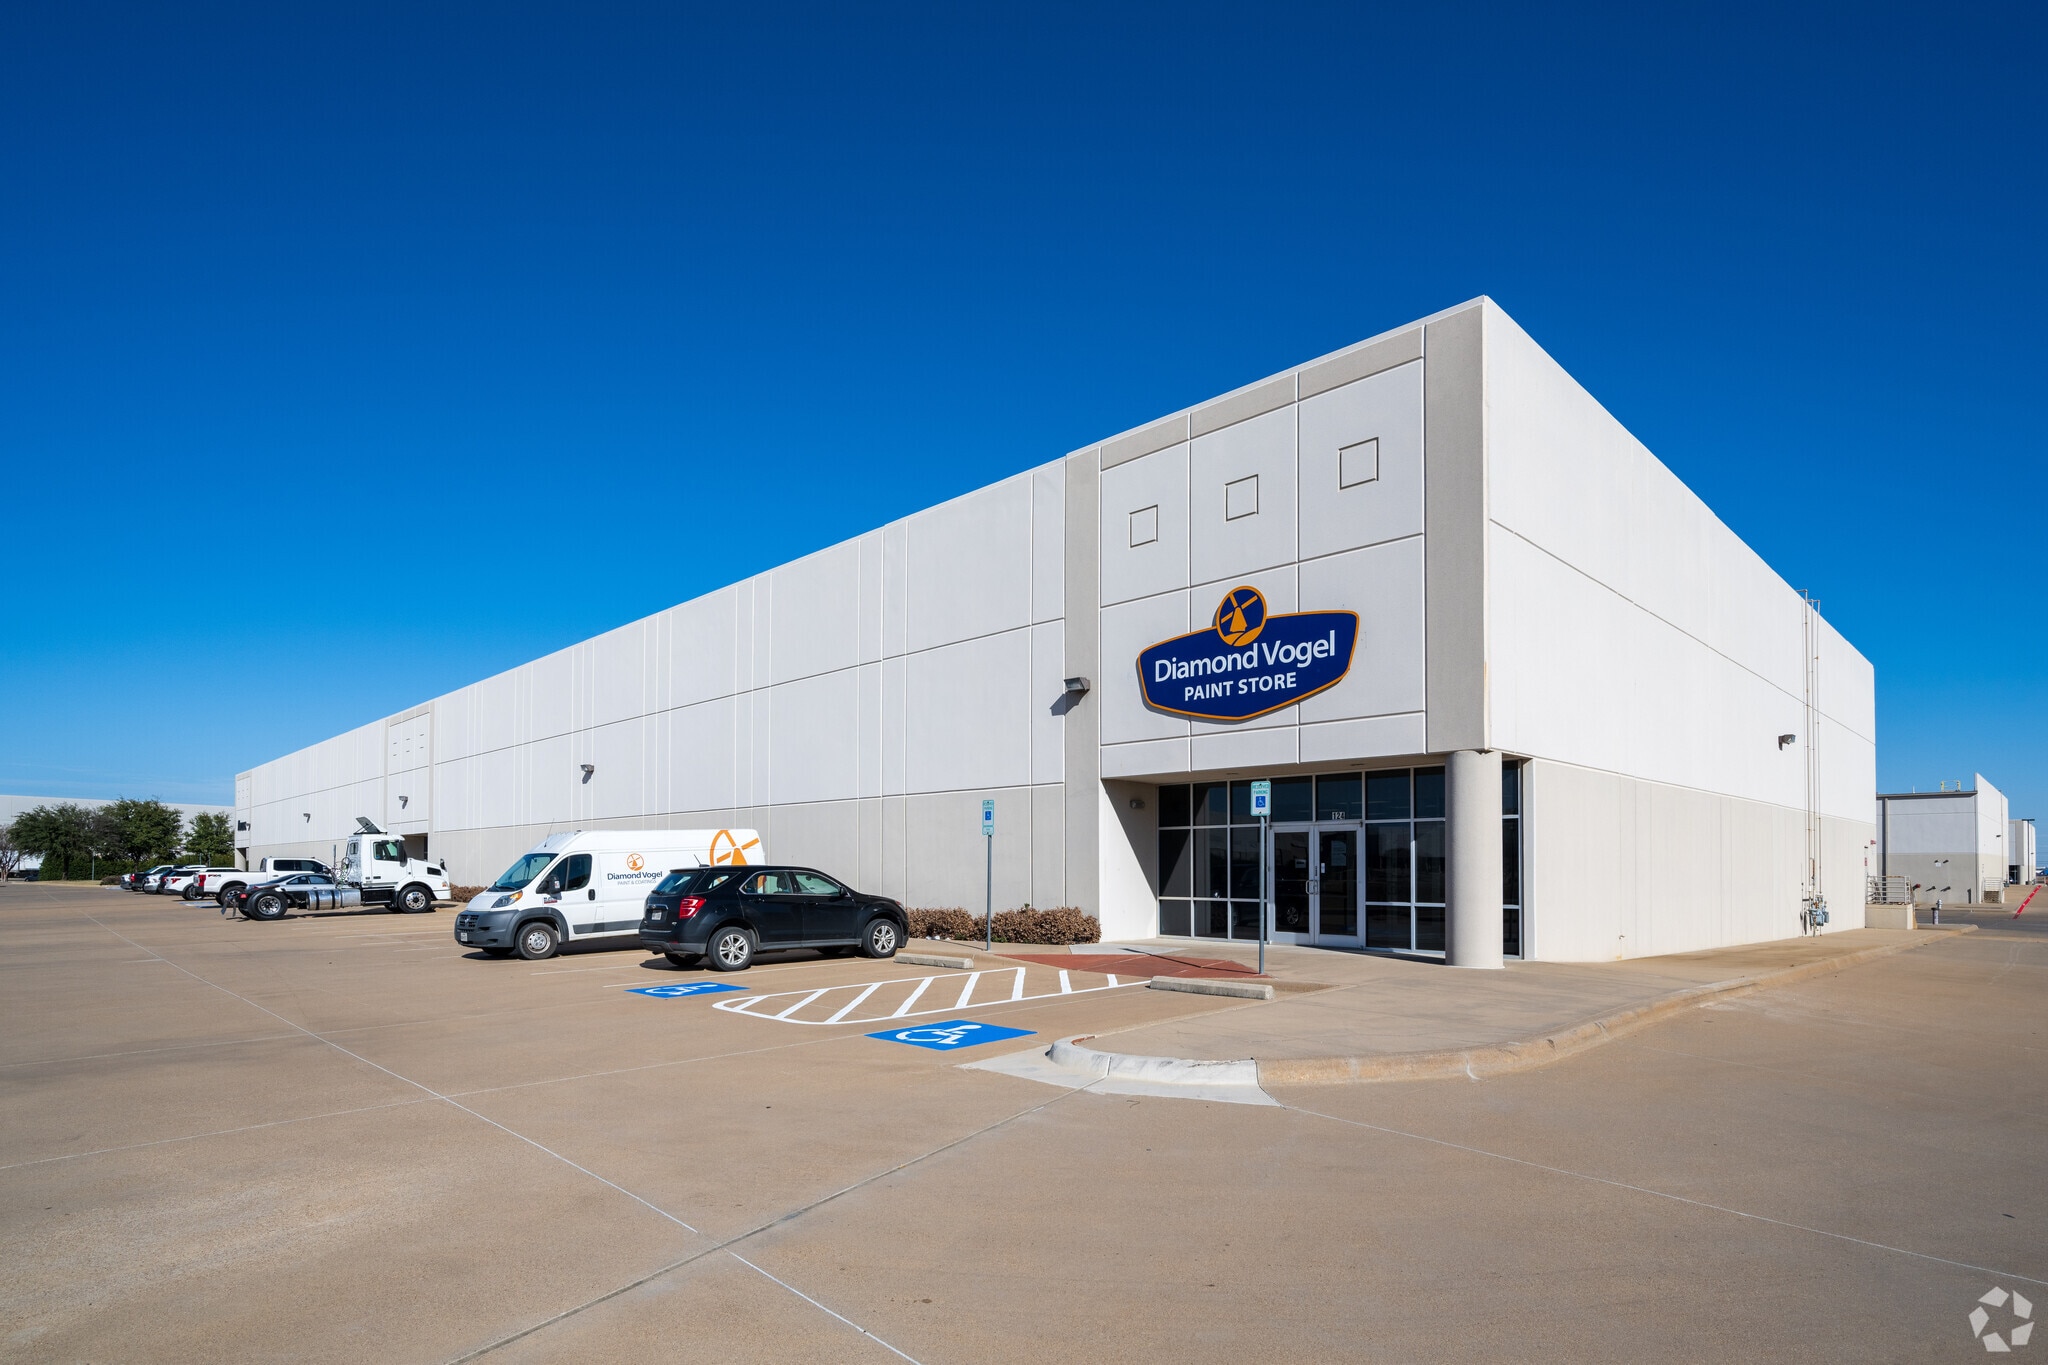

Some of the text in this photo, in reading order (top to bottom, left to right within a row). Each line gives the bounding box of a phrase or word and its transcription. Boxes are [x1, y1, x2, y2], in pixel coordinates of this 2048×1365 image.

[1155, 630, 1335, 683] Diamond Vogel
[1184, 672, 1297, 701] PAINT STORE
[1333, 812, 1344, 820] 124
[607, 871, 663, 880] Diamond Vogel
